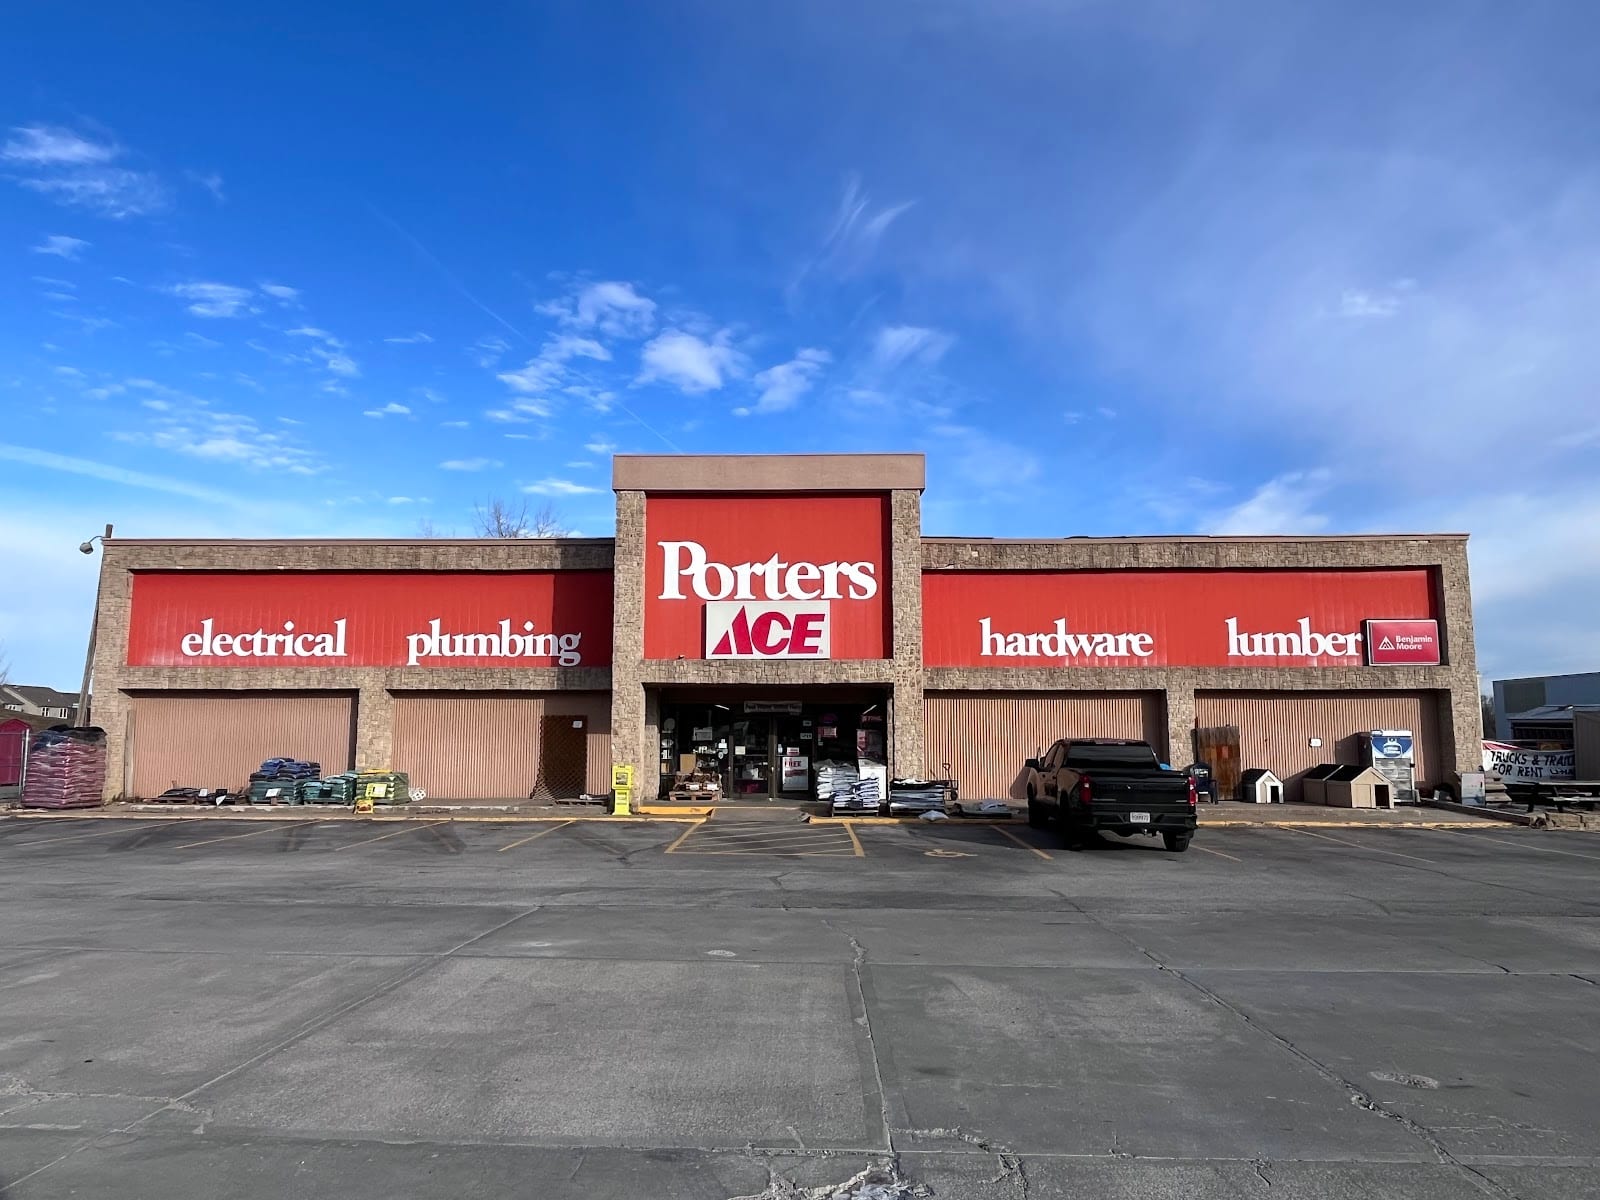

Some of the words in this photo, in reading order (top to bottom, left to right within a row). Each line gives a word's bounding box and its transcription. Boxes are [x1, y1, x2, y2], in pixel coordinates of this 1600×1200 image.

[657, 541, 878, 600] Porters
[181, 618, 347, 658] electrical
[406, 618, 582, 666] plumbing
[712, 606, 826, 655] ACE
[979, 617, 1154, 657] hardware
[1225, 616, 1363, 657] lumber
[1395, 635, 1432, 644] Benjamin
[1491, 751, 1528, 766] TRUCKS
[1531, 755, 1540, 766] &
[1493, 763, 1512, 776] FOR
[1517, 766, 1544, 778] RENT
